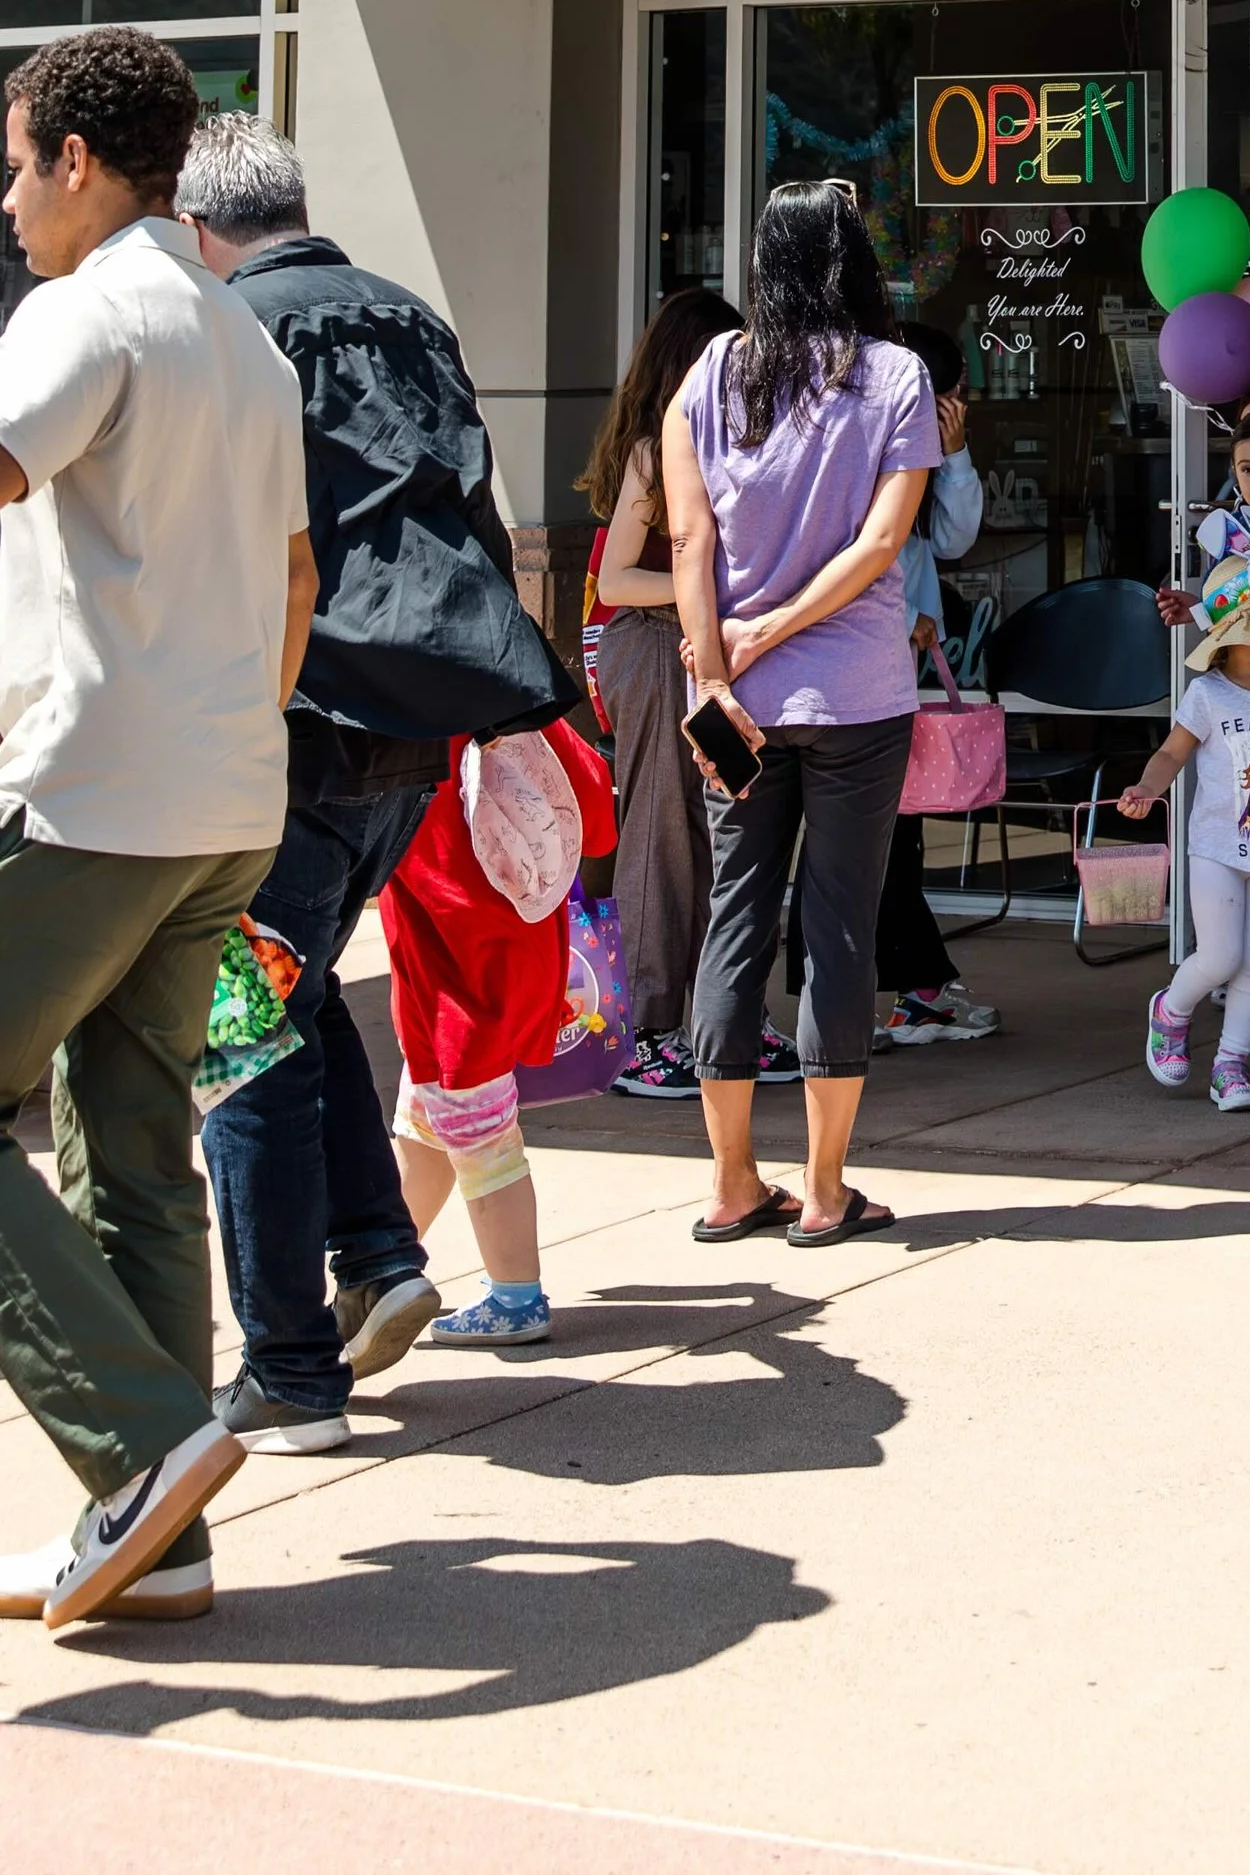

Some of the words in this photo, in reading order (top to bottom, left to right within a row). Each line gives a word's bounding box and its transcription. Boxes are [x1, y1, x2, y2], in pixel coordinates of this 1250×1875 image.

[928, 81, 1134, 185] OPEN
[996, 256, 1071, 287] Delighted
[987, 294, 1017, 326] You
[1018, 305, 1042, 317] are
[1044, 292, 1084, 317] Here.
